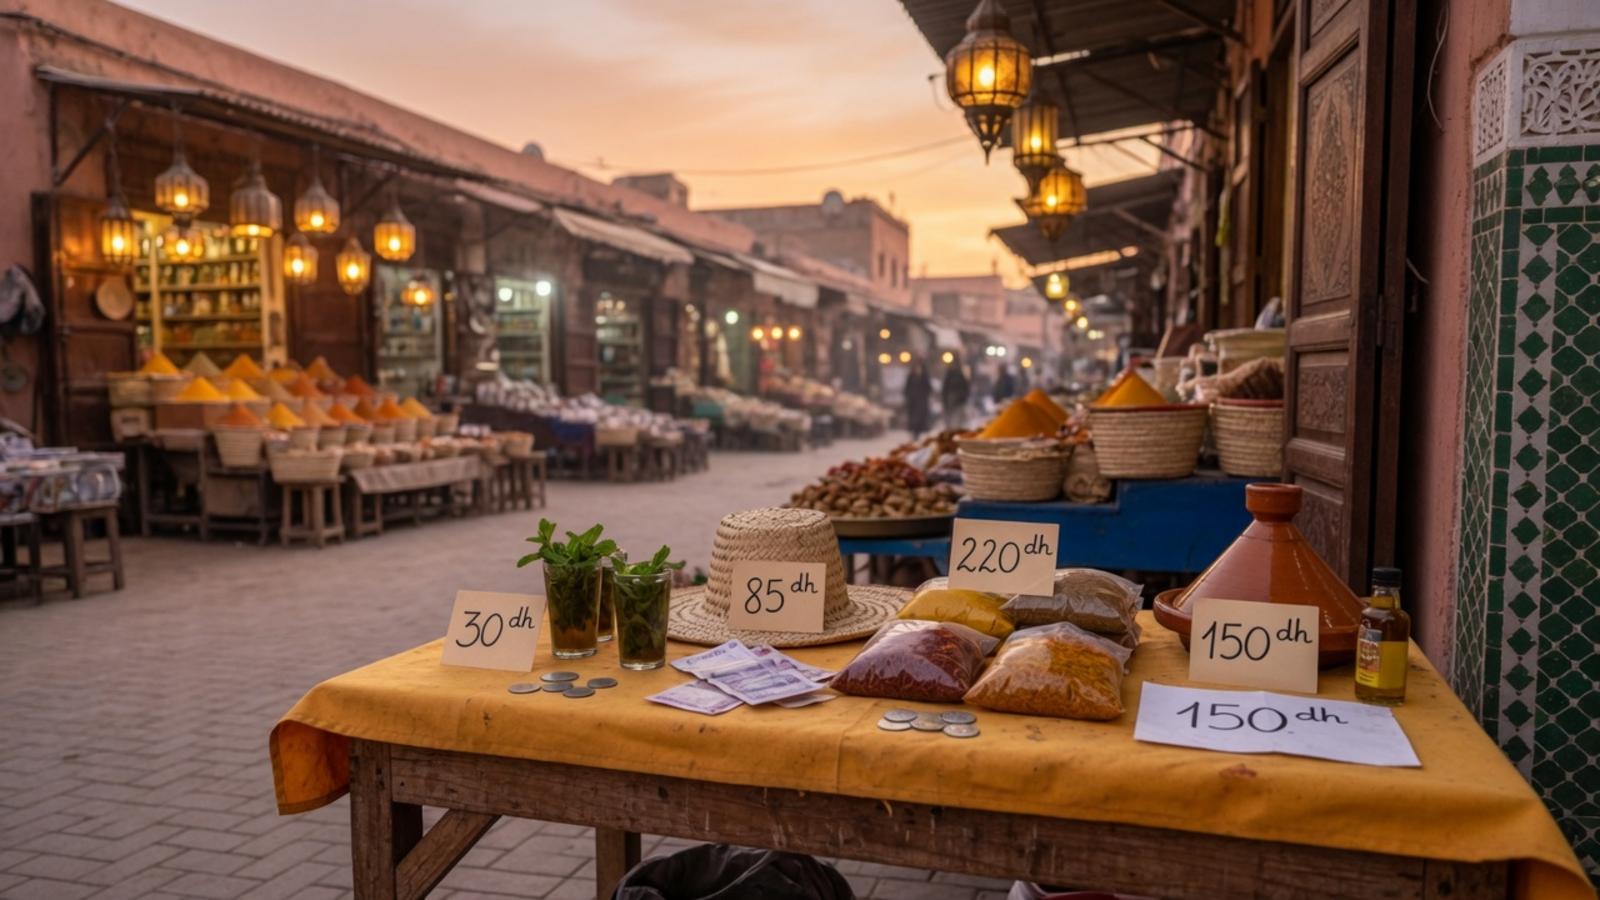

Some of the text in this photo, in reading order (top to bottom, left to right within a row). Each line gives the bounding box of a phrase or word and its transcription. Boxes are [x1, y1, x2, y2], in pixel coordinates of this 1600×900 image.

[956, 533, 1053, 574] 220 dh
[744, 572, 819, 615] 85 dh
[455, 605, 536, 648] 30 dh
[1201, 617, 1313, 662] 150 dh
[1176, 701, 1349, 733] 150 dh
